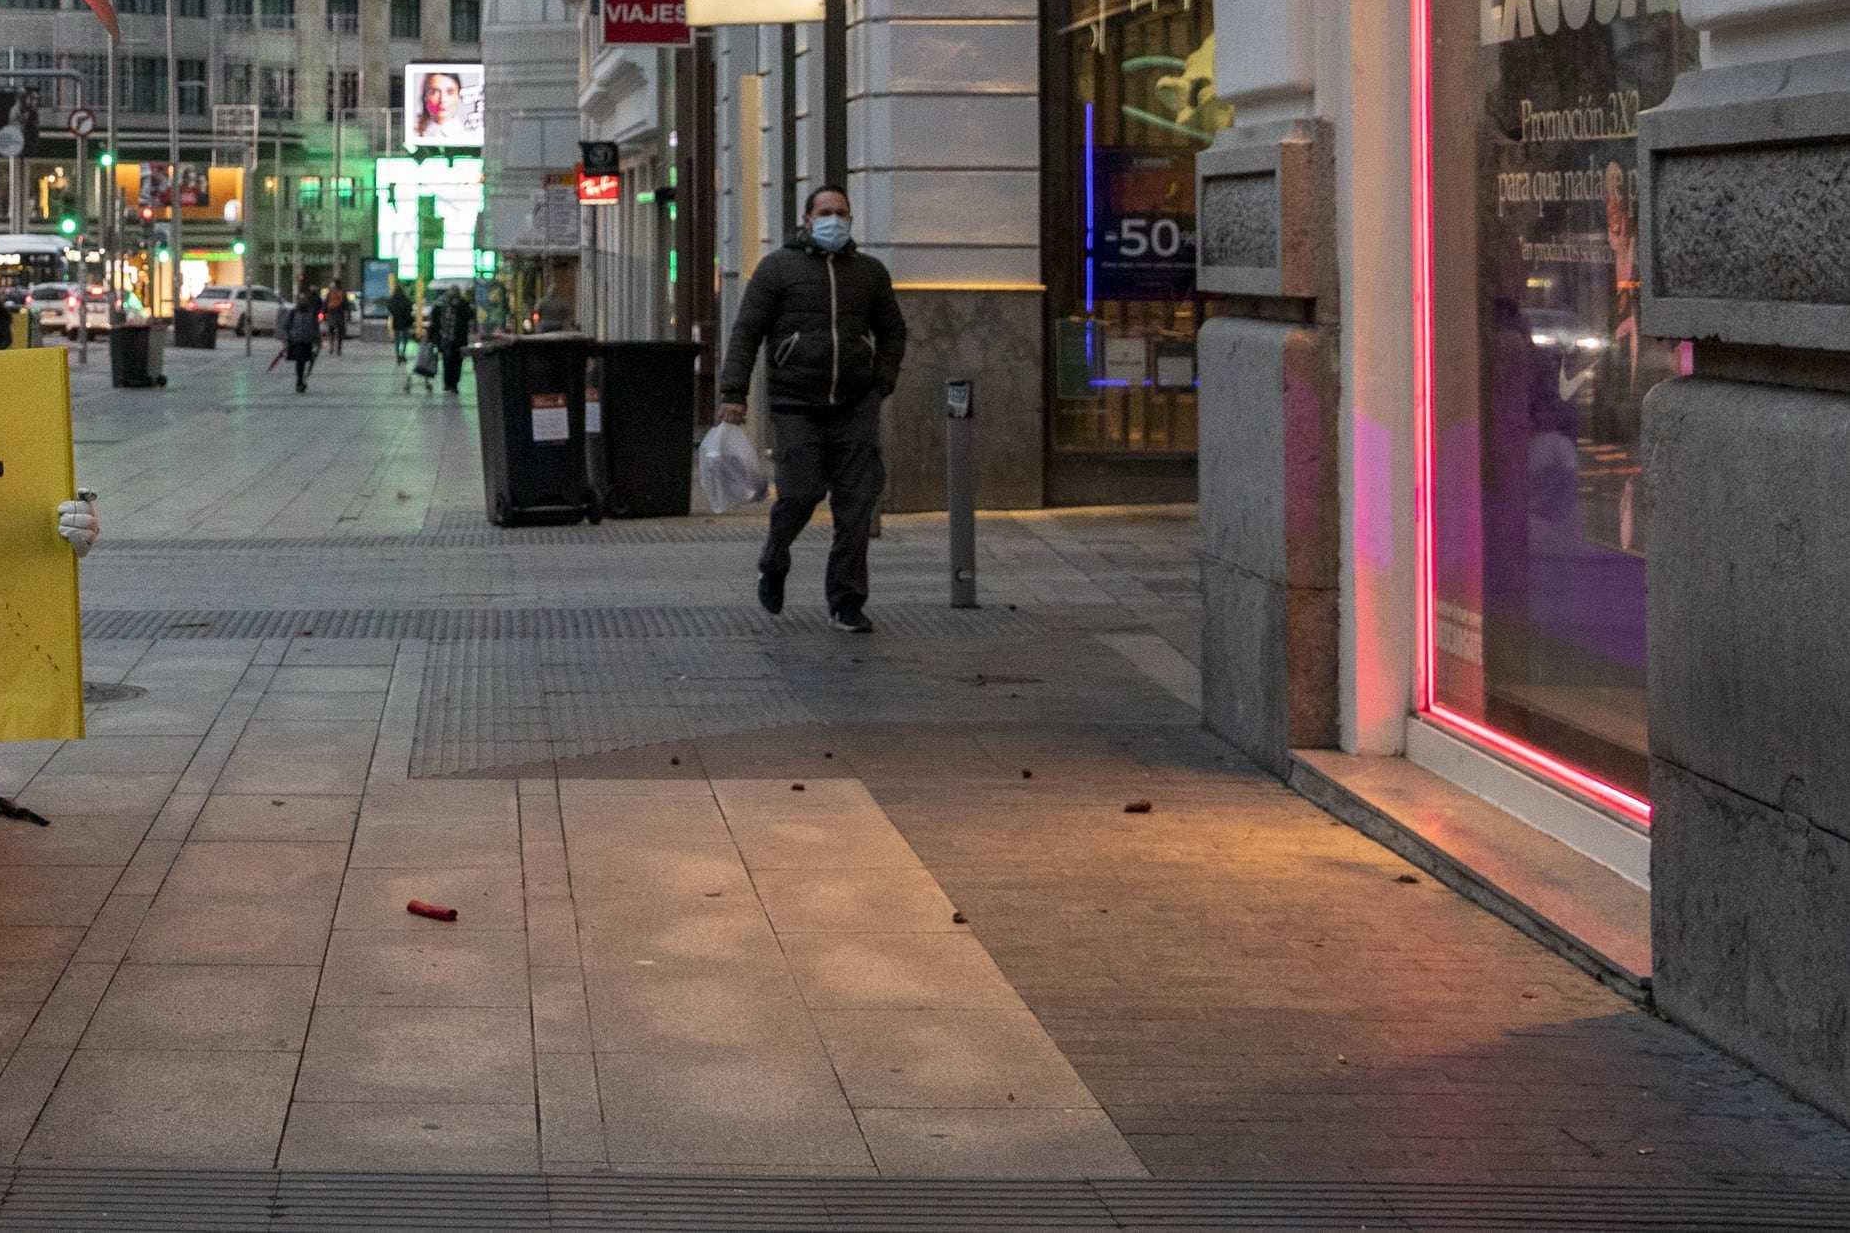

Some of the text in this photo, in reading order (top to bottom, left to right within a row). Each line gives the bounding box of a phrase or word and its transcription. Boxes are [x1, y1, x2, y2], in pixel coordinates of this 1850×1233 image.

[606, 3, 686, 24] VIAJES
[1520, 89, 1639, 142] Promoción 3X2
[1497, 170, 1530, 217] para
[1532, 170, 1562, 217] que
[1564, 154, 1604, 201] nada
